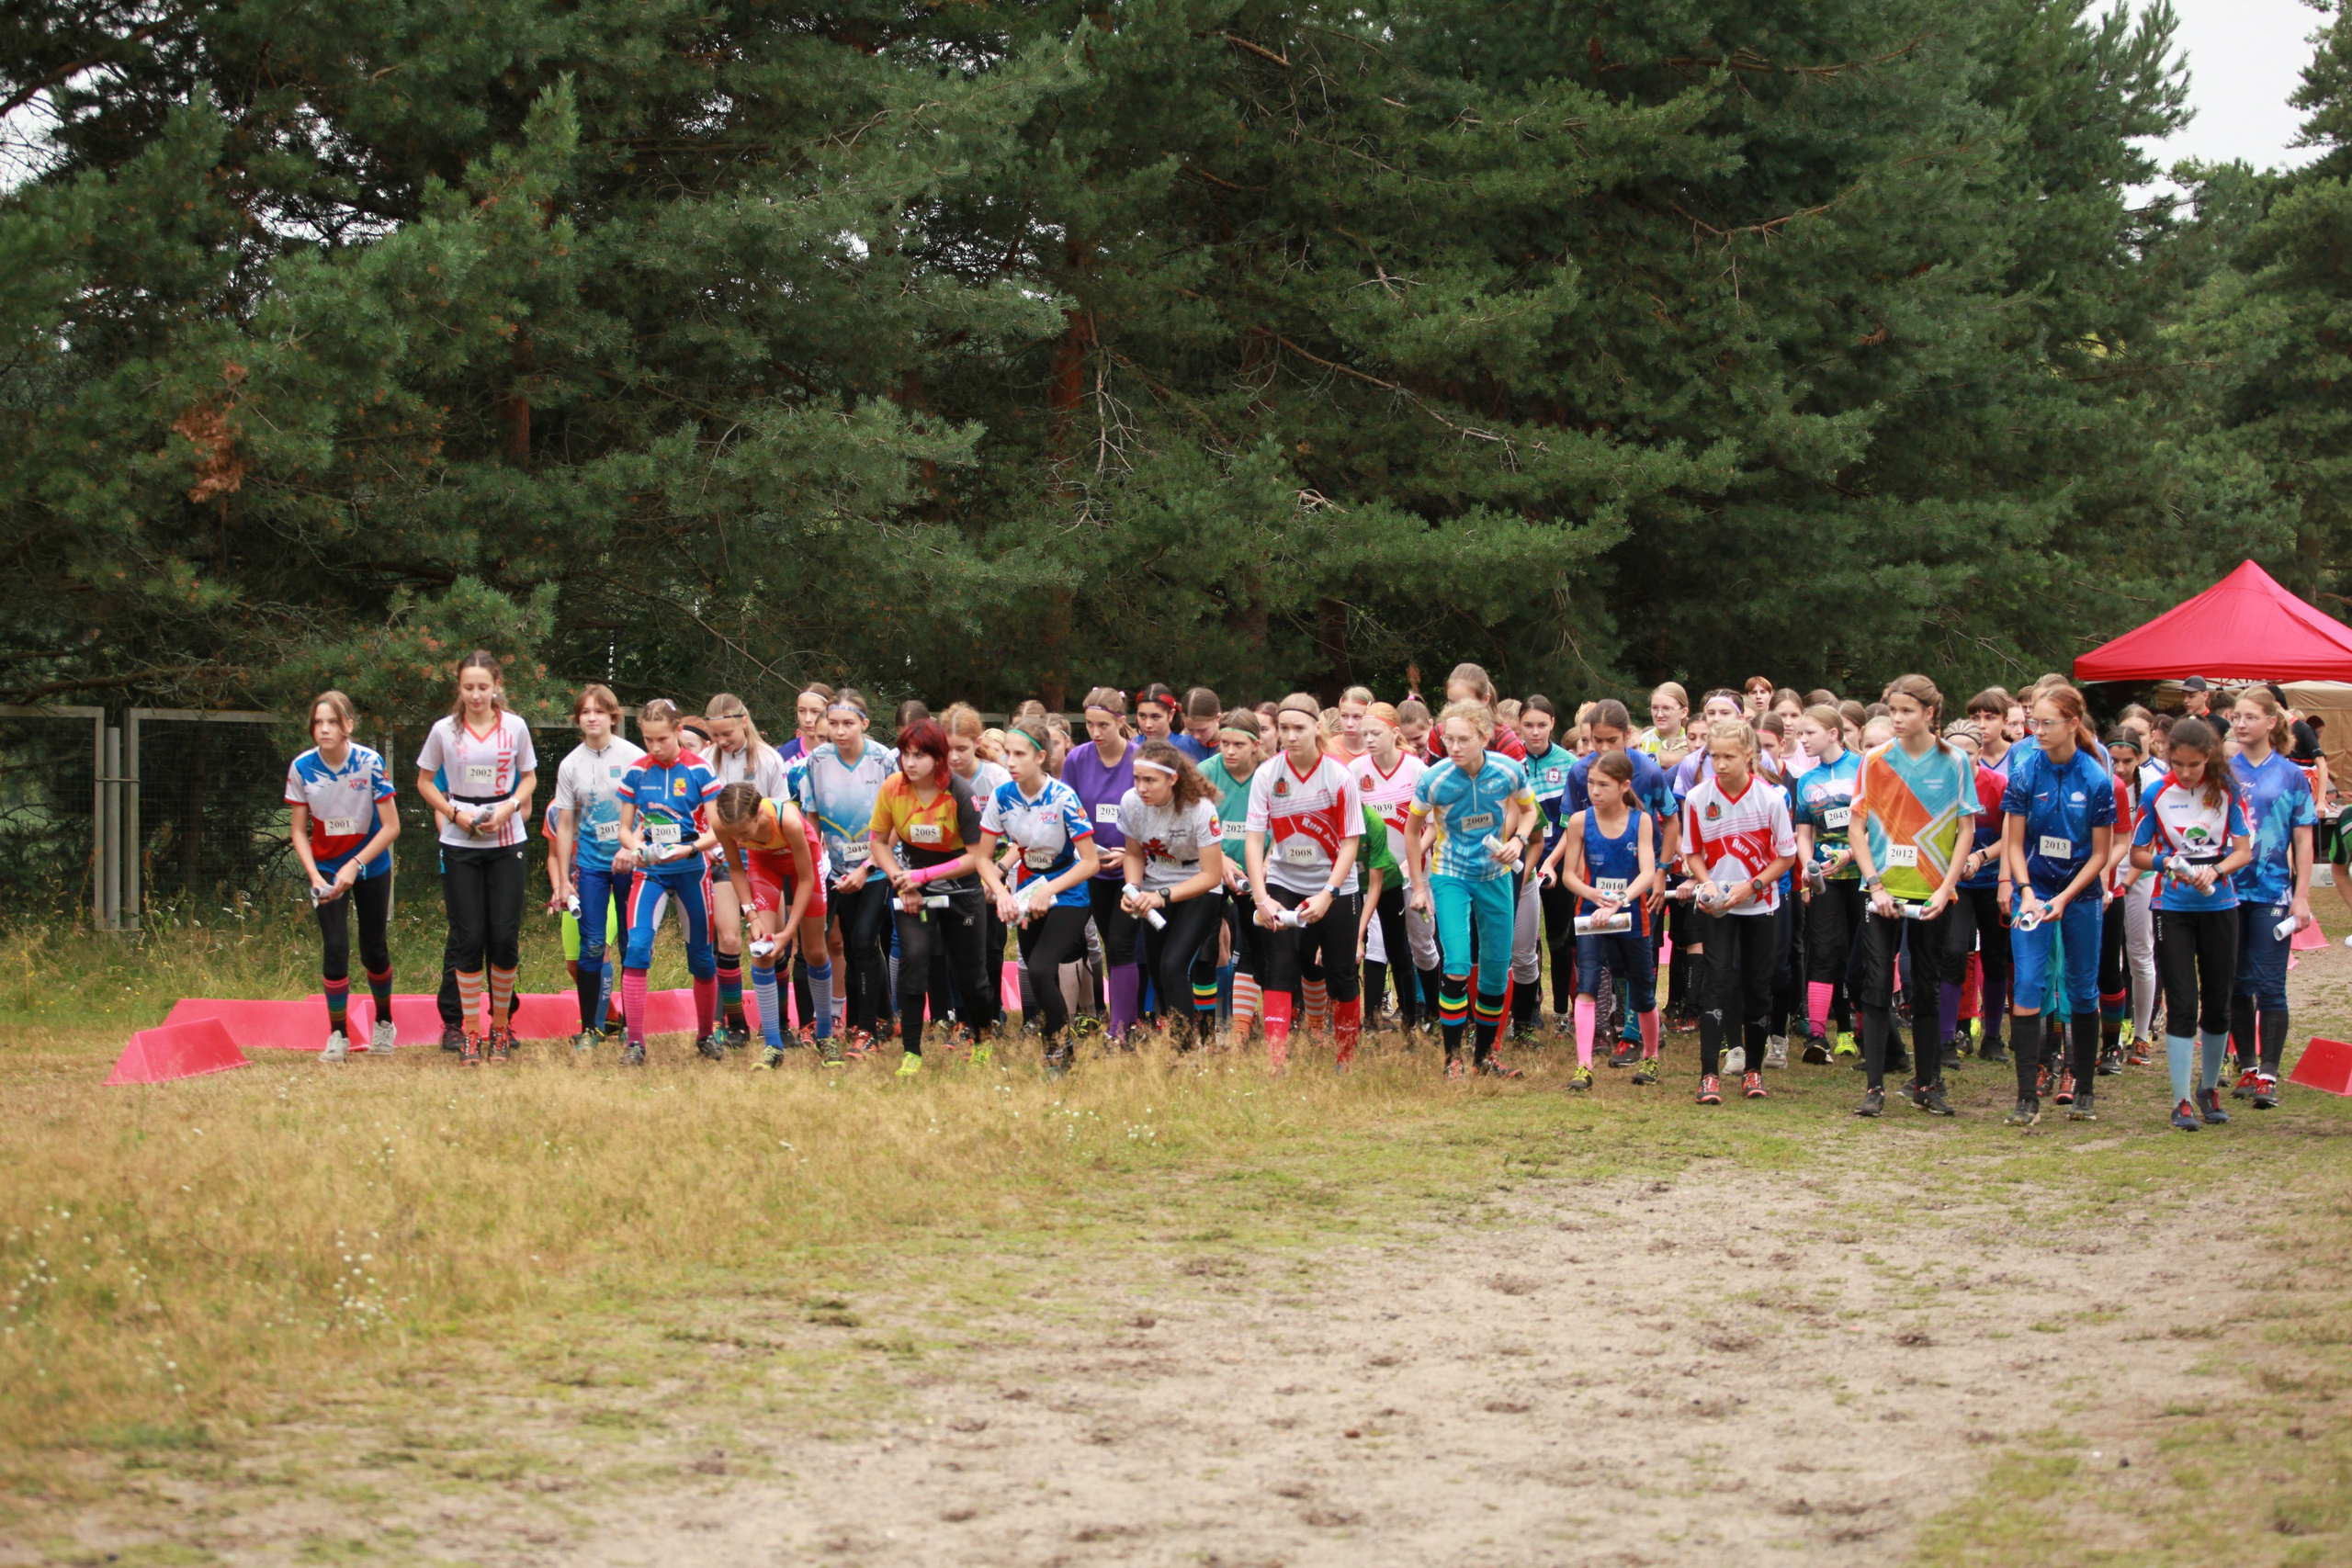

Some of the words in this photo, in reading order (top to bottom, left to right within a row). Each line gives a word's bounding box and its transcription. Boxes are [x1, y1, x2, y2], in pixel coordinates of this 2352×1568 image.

[470, 769, 492, 777] 2002
[1466, 816, 1489, 826] 2009
[1828, 810, 1849, 821] 2043
[329, 820, 350, 829] 2001
[600, 823, 620, 835] 2017
[1226, 824, 1247, 834] 2022
[1301, 817, 1323, 834] Run
[656, 828, 677, 837] 2003
[914, 828, 937, 837] 2005
[847, 843, 869, 854] 2019
[1732, 838, 1750, 856] Run
[2044, 840, 2067, 851] 2013
[1027, 853, 1049, 864] 2006
[1290, 849, 1313, 857] 2008
[1890, 848, 1914, 859] 2012
[1600, 881, 1623, 890] 2010
[601, 976, 612, 1000] TAKE
